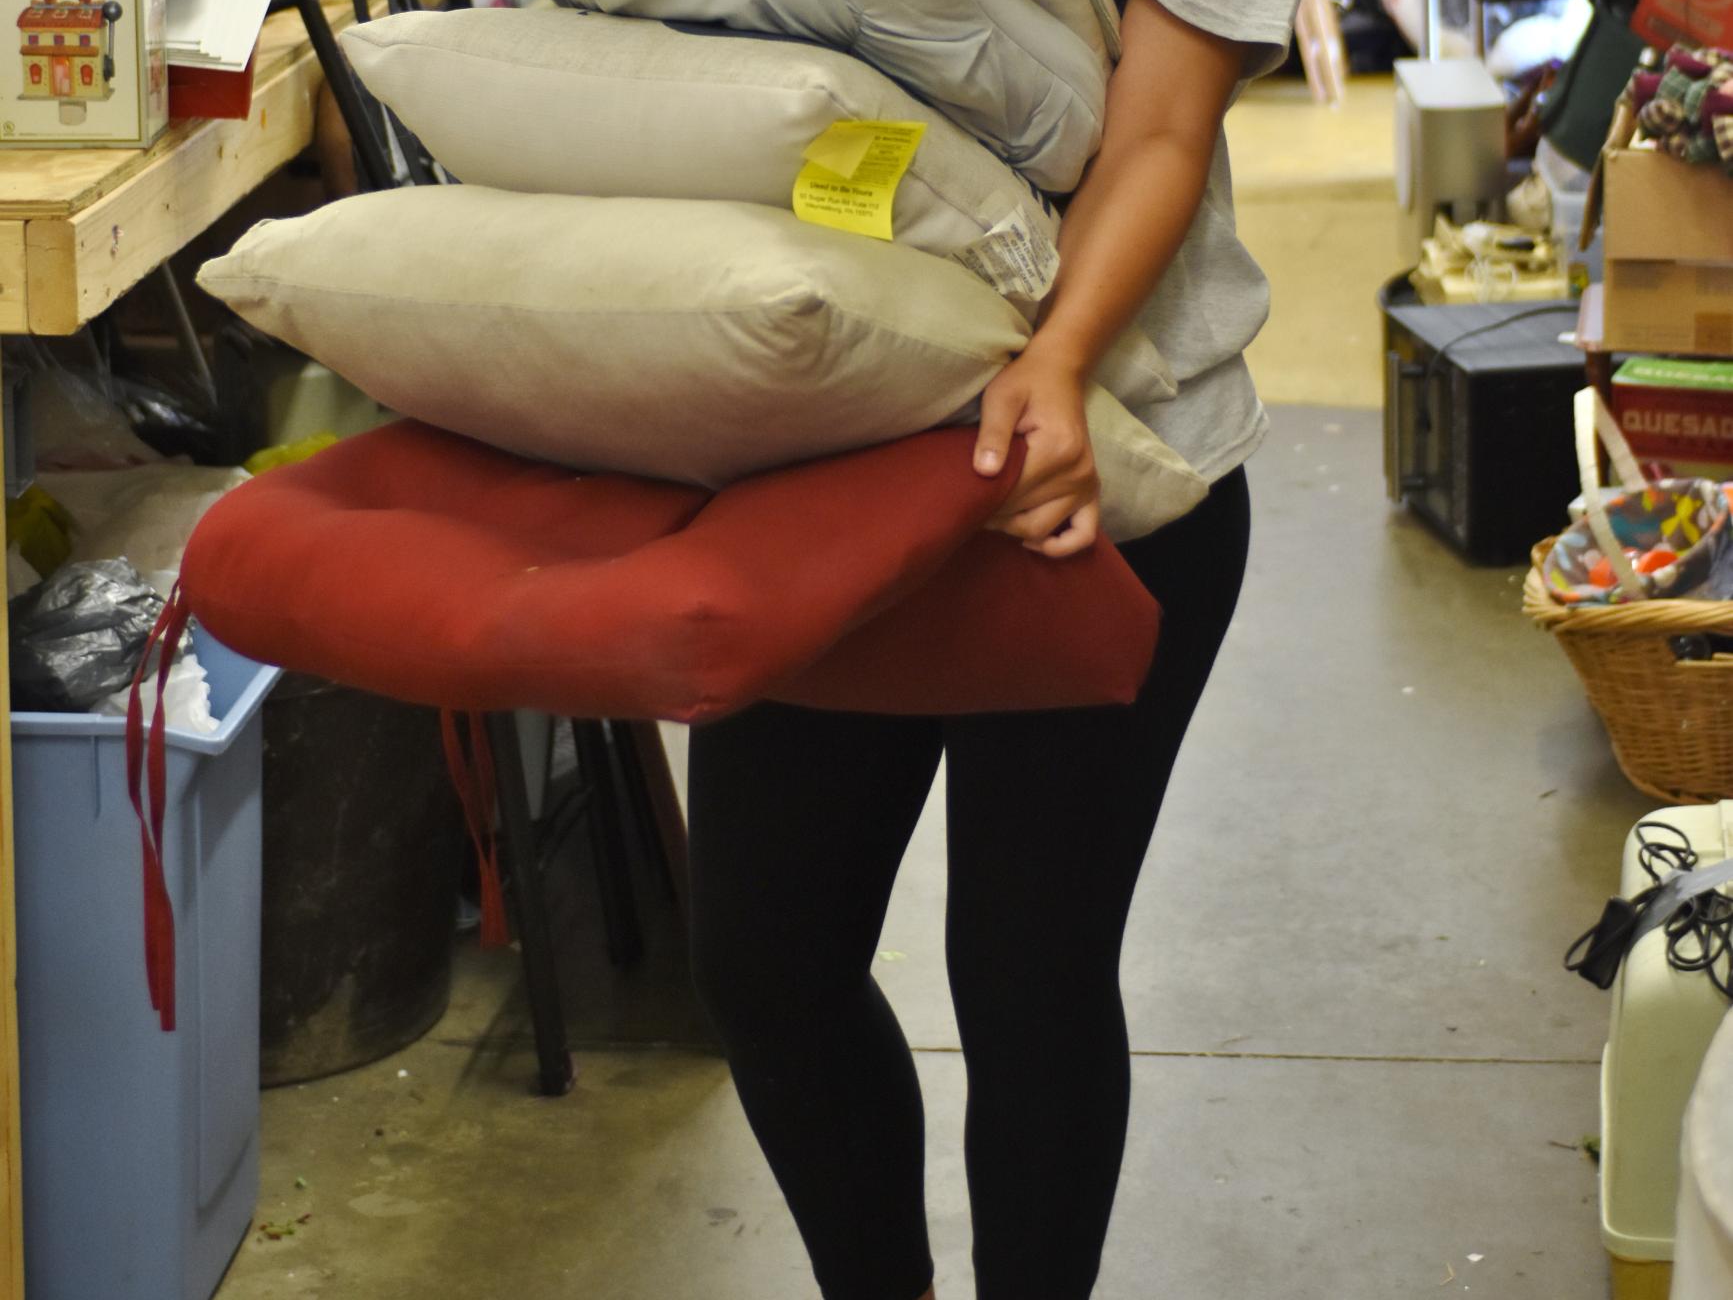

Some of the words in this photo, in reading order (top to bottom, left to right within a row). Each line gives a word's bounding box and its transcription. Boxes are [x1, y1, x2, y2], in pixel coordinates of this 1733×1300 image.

[810, 181, 829, 191] Used
[830, 184, 839, 192] to
[839, 185, 851, 193] Be
[852, 187, 873, 197] Yours
